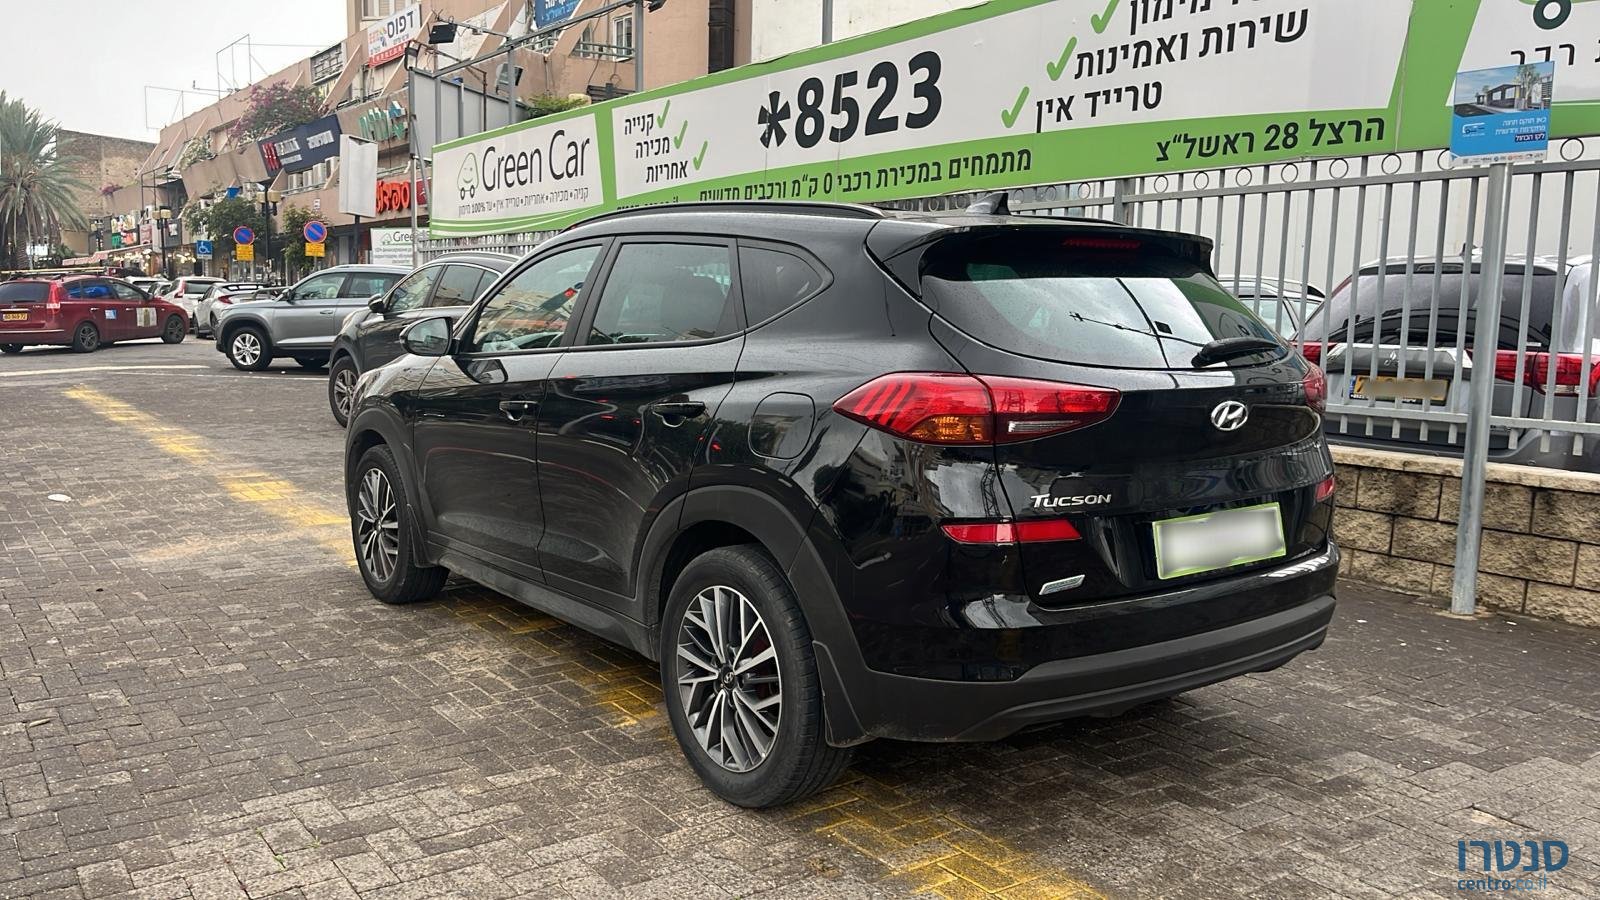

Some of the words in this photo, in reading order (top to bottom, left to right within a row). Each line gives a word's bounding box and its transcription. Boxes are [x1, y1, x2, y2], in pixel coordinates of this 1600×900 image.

[387, 11, 414, 38] דפוס
[1198, 8, 1309, 58] שירות
[1074, 32, 1189, 80] ואמינות
[1084, 81, 1163, 118] טרייד
[624, 113, 654, 136] קנייה
[1036, 95, 1075, 134] אין
[1263, 122, 1300, 152] 28
[1308, 117, 1385, 147] הרצל
[635, 136, 670, 159] מכירה
[482, 146, 542, 191] Green
[549, 129, 590, 181] Car
[645, 160, 689, 183] אחריות
[948, 148, 1032, 179] מתמחים
[822, 172, 833, 195] 0
[837, 169, 871, 193] רכבי
[876, 160, 943, 188] במכירת
[506, 196, 520, 208] טרייד
[523, 193, 545, 206] אחריות
[550, 190, 569, 203] מכירה
[574, 187, 590, 202] קניה
[744, 181, 787, 200] ורכבים
[496, 199, 504, 213] אין
